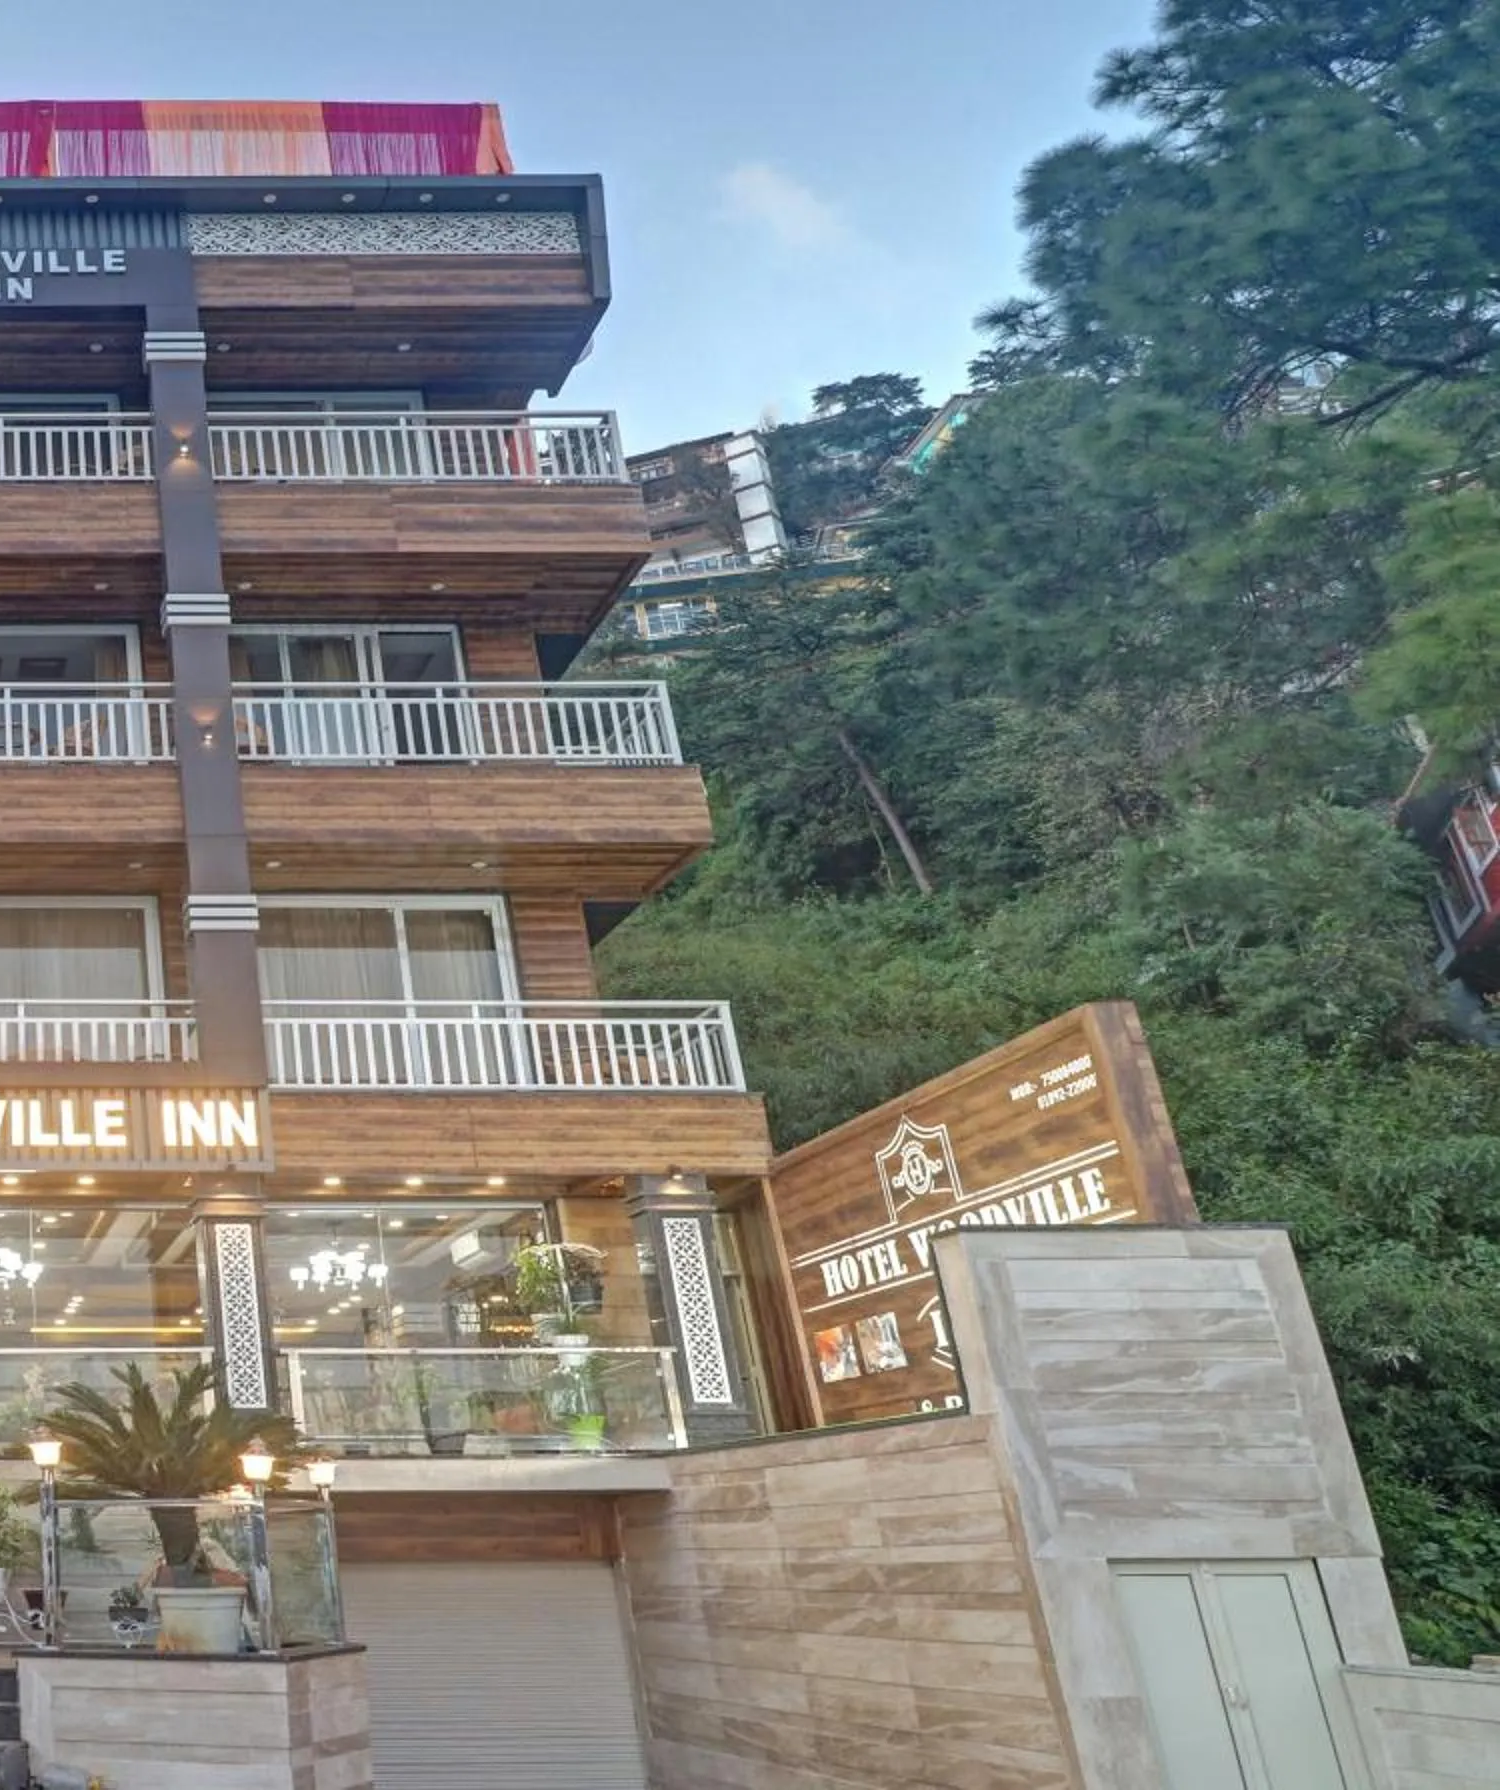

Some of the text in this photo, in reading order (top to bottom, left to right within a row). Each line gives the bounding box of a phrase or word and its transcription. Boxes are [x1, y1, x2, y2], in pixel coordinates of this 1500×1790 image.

[161, 1098, 260, 1148] INN
[819, 1167, 1111, 1298] HOTEL WVILLE
